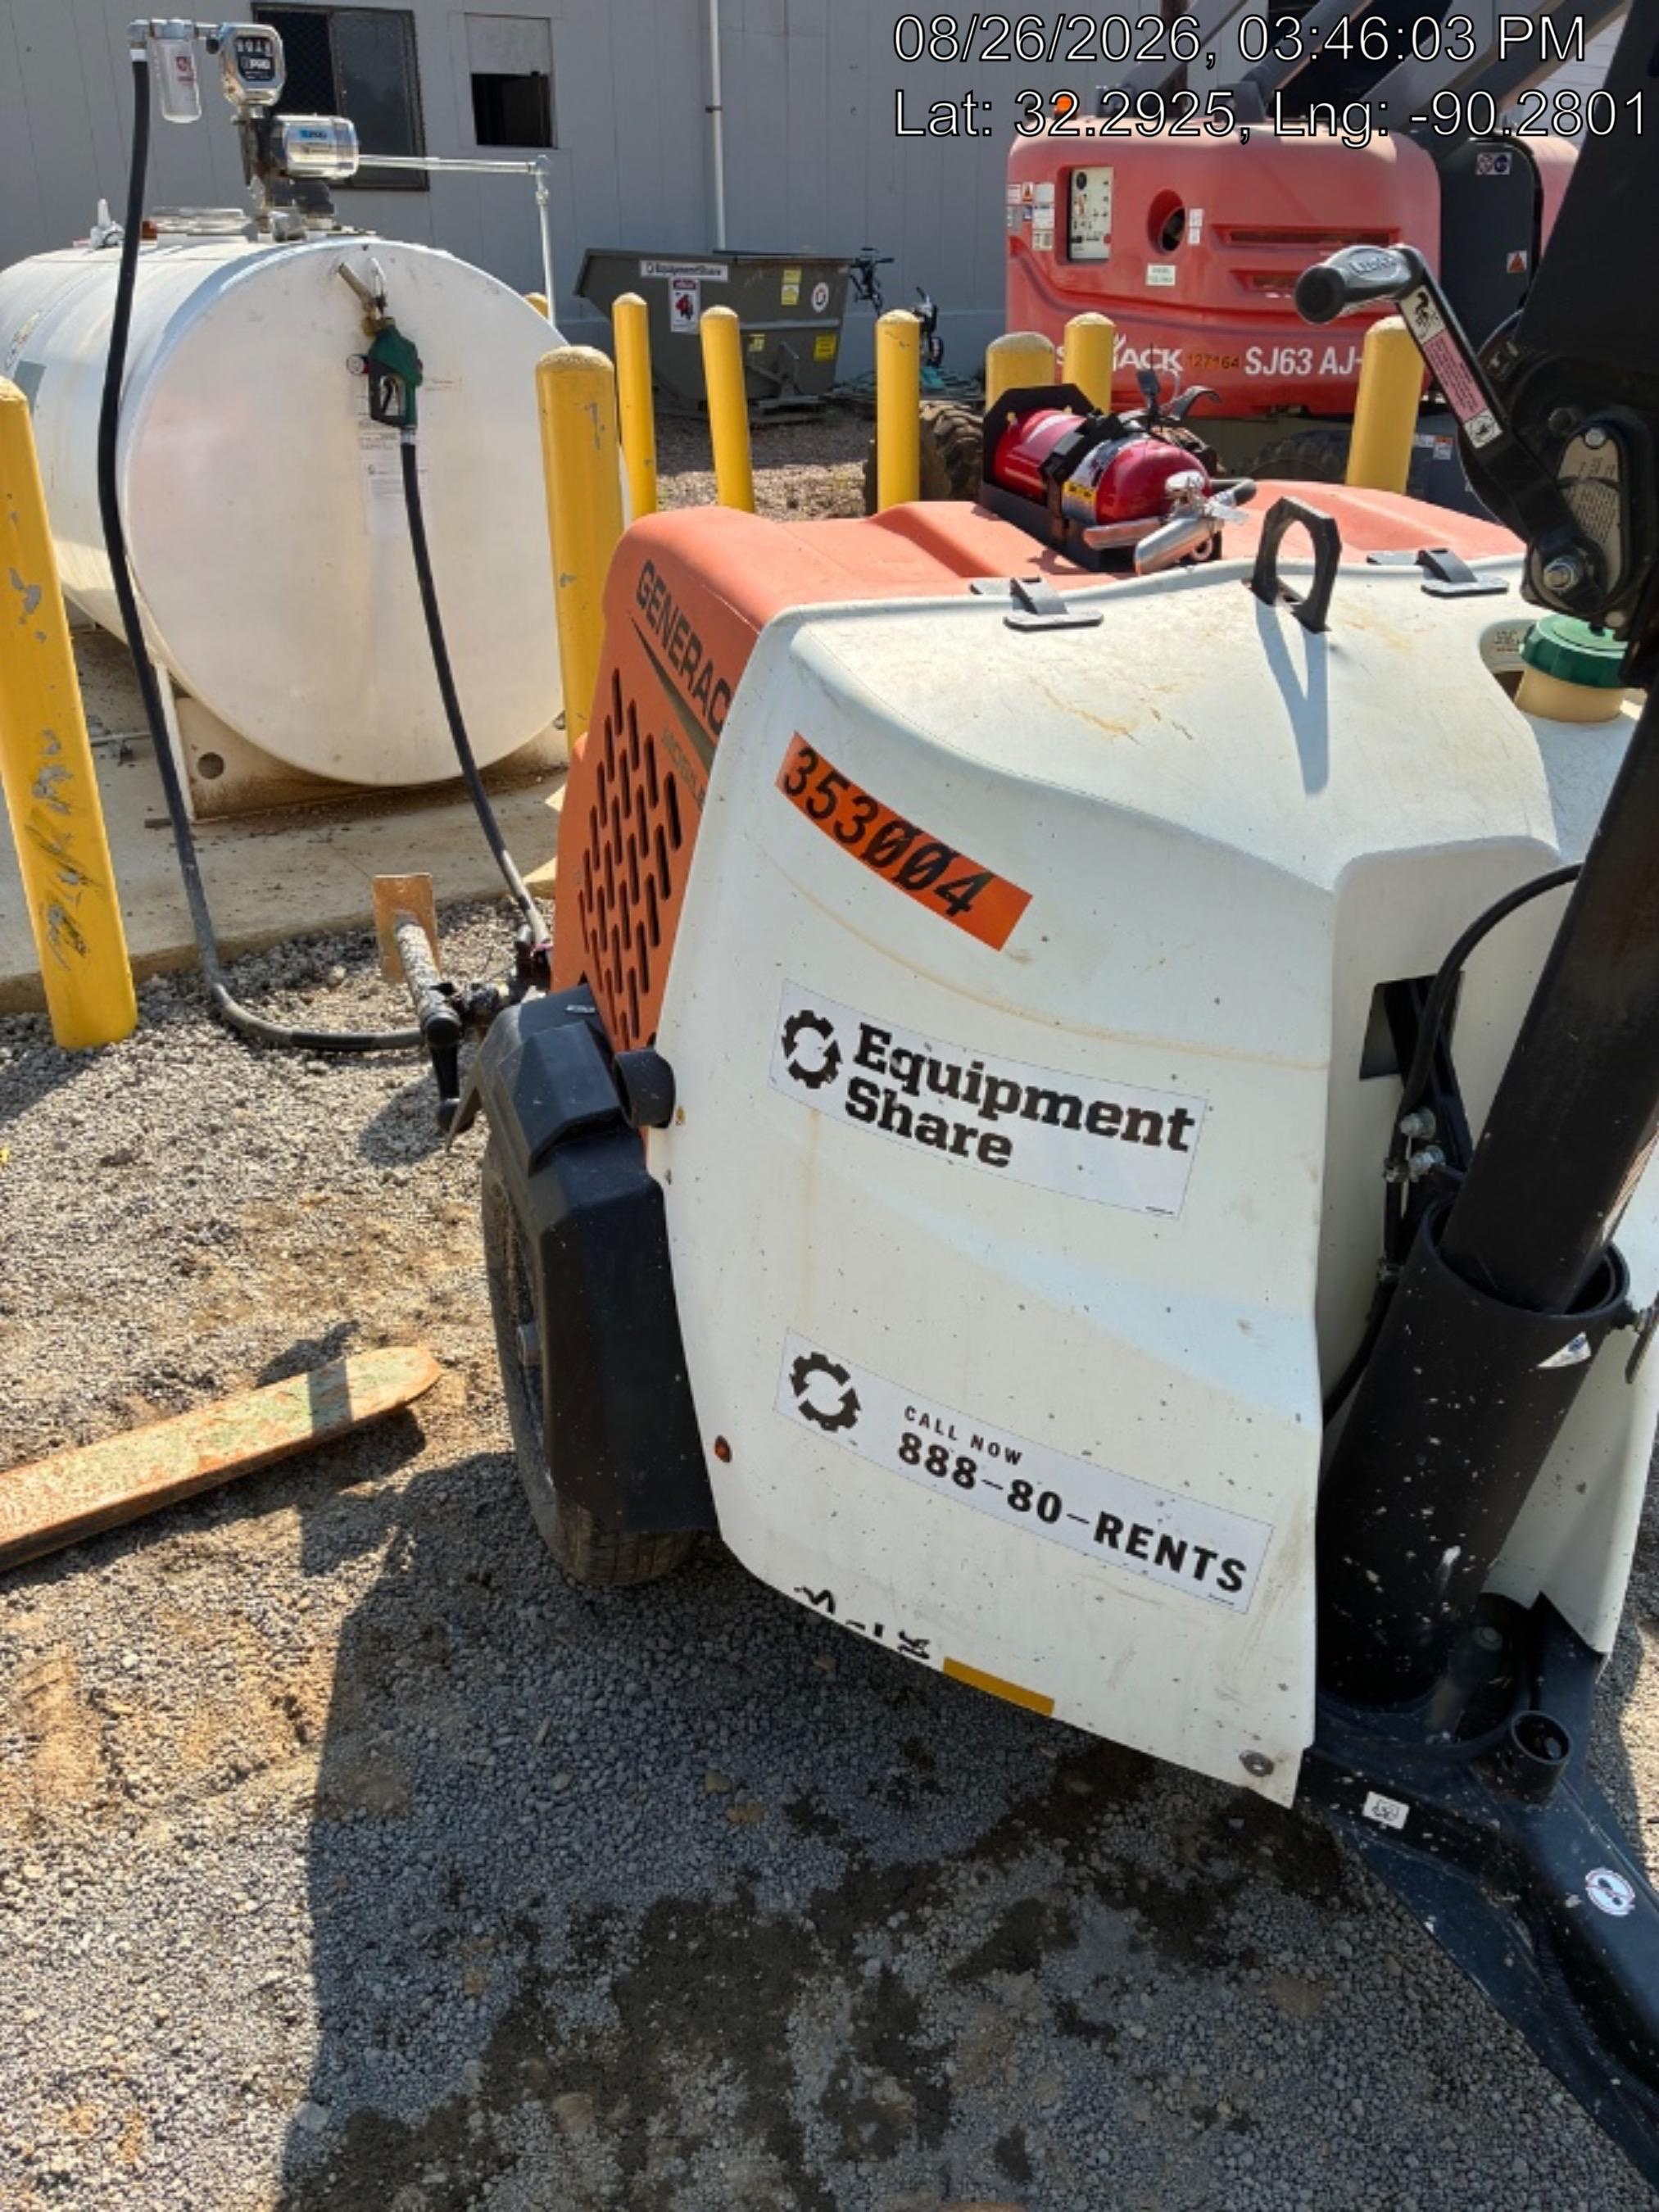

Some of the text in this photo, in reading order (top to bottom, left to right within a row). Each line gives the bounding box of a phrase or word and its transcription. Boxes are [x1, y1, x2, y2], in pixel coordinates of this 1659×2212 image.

[1244, 346, 1313, 375] SJ63
[636, 558, 732, 737] GENERAC
[845, 1077, 1013, 1167] Share
[853, 1021, 1195, 1152] Equipment
[904, 1405, 1022, 1466] CALL NOW
[898, 1430, 1248, 1593] 888-80-RENTS
